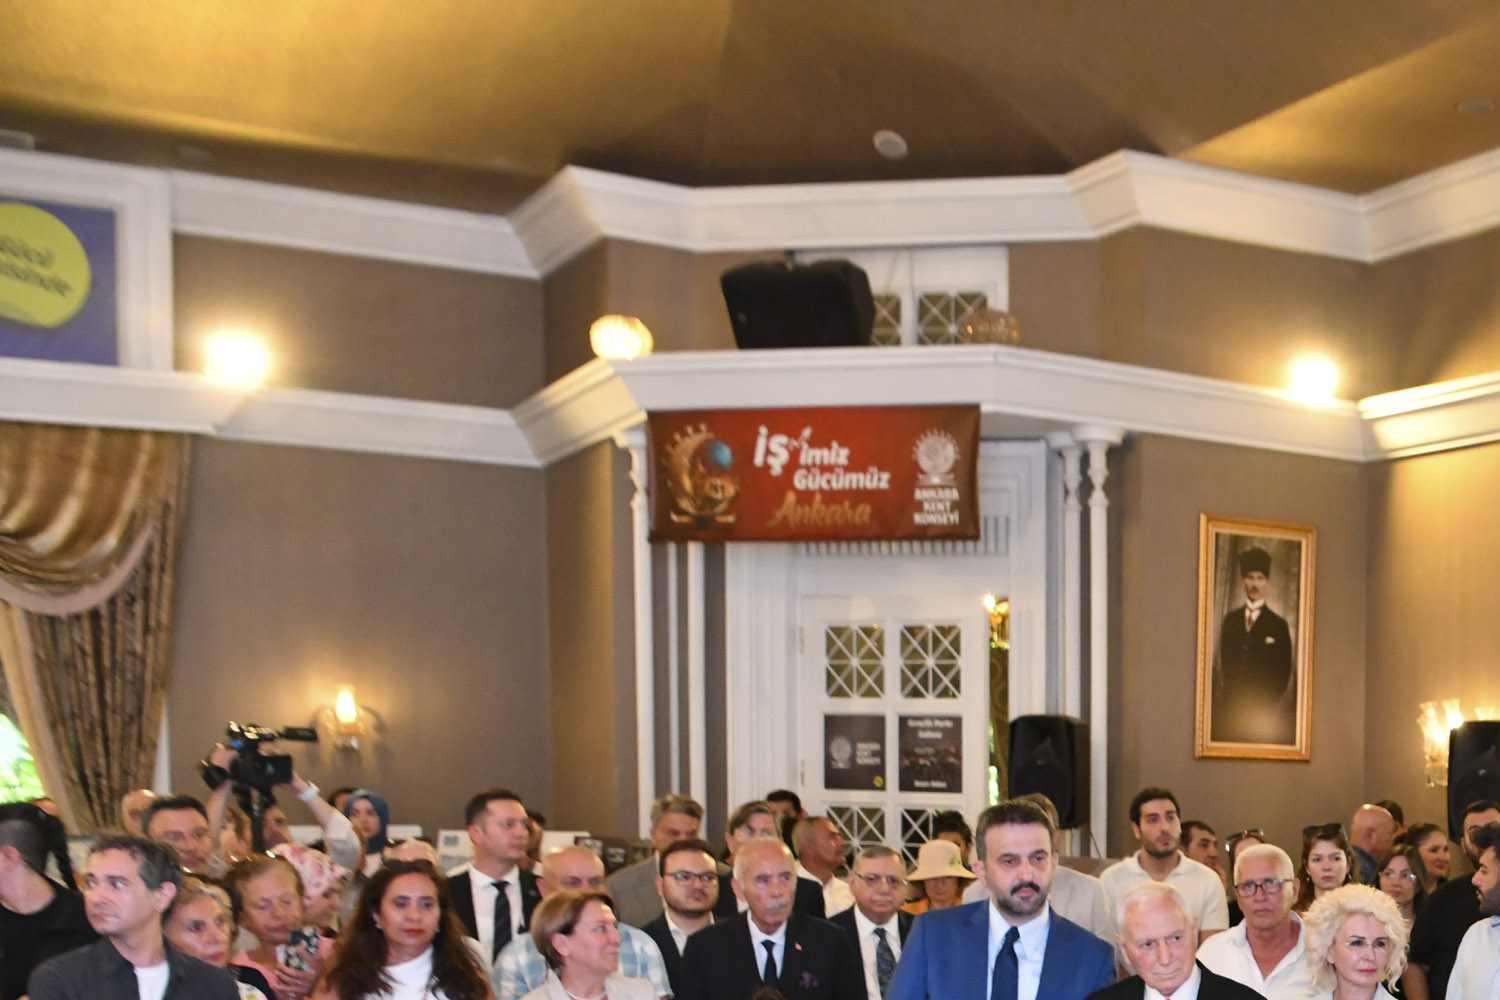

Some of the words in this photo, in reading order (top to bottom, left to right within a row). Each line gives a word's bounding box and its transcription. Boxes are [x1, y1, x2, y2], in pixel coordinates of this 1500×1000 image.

[792, 465, 891, 491] Gücümüz
[914, 487, 960, 500] ANKARA
[766, 489, 872, 528] Ankara
[923, 500, 951, 512] KENT
